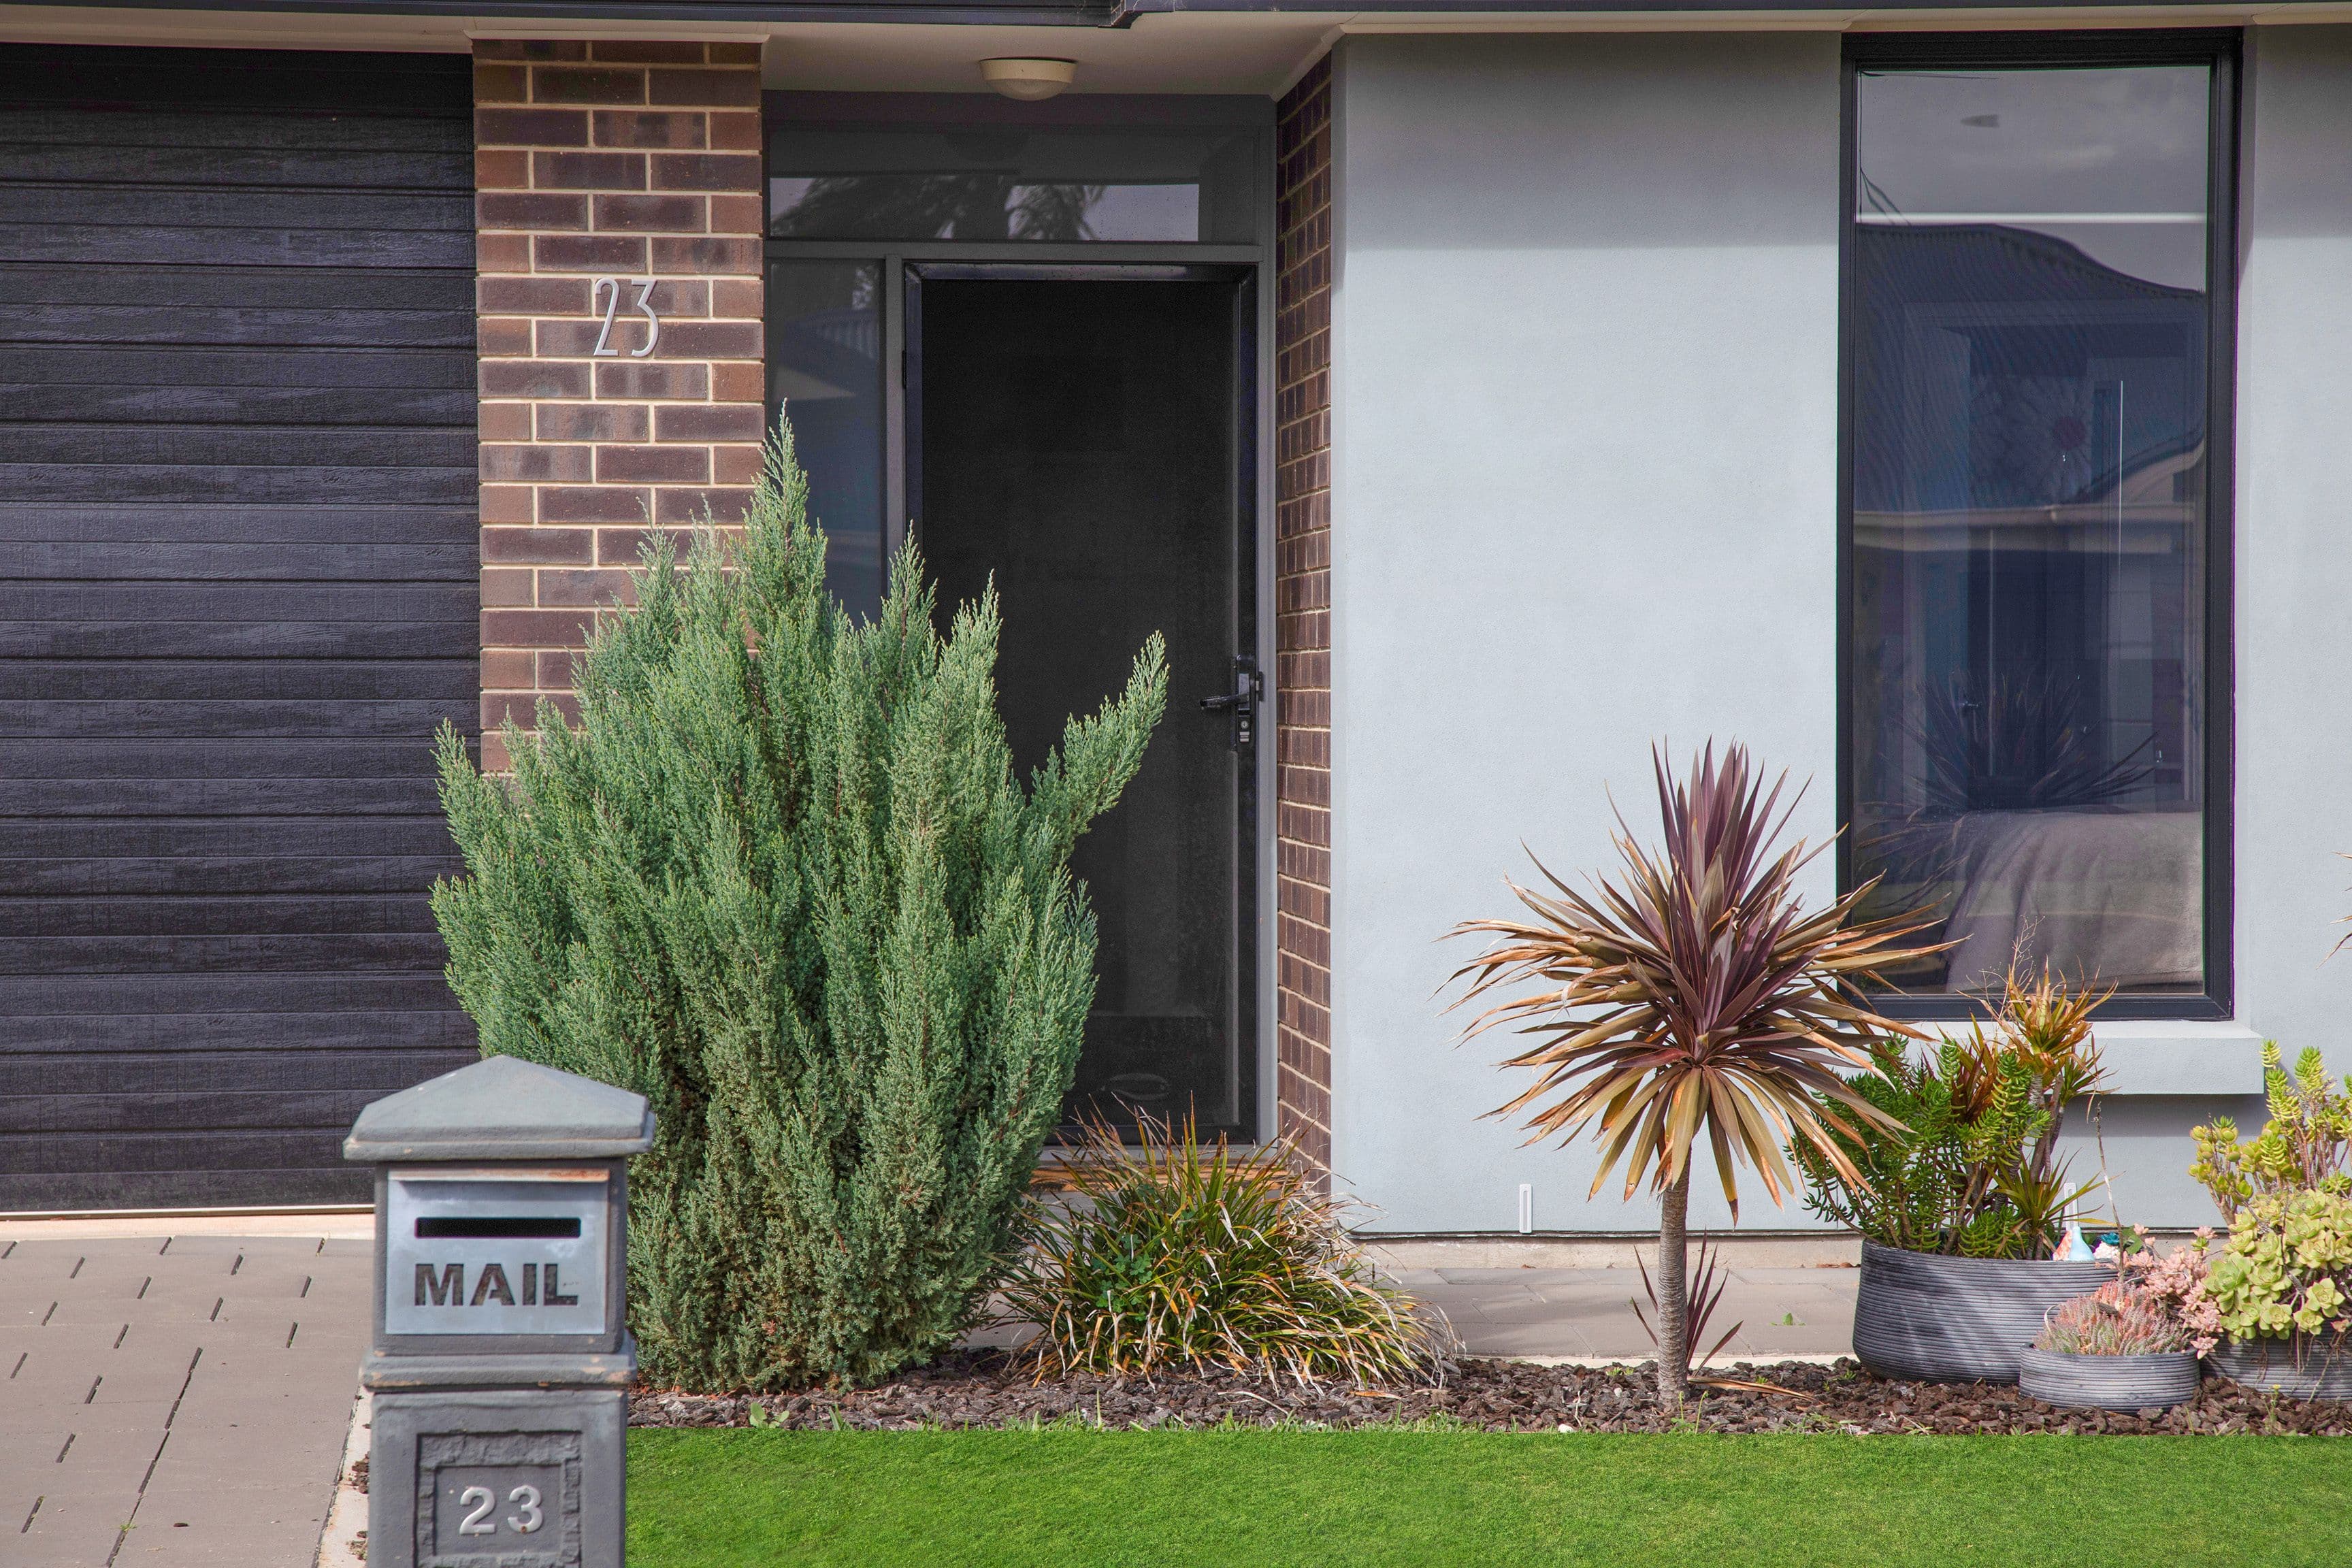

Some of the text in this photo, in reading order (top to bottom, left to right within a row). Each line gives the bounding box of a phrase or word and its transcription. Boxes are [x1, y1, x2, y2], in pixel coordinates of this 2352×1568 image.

[593, 277, 659, 357] 23
[414, 1262, 578, 1306] MAIL
[458, 1484, 544, 1535] 23
